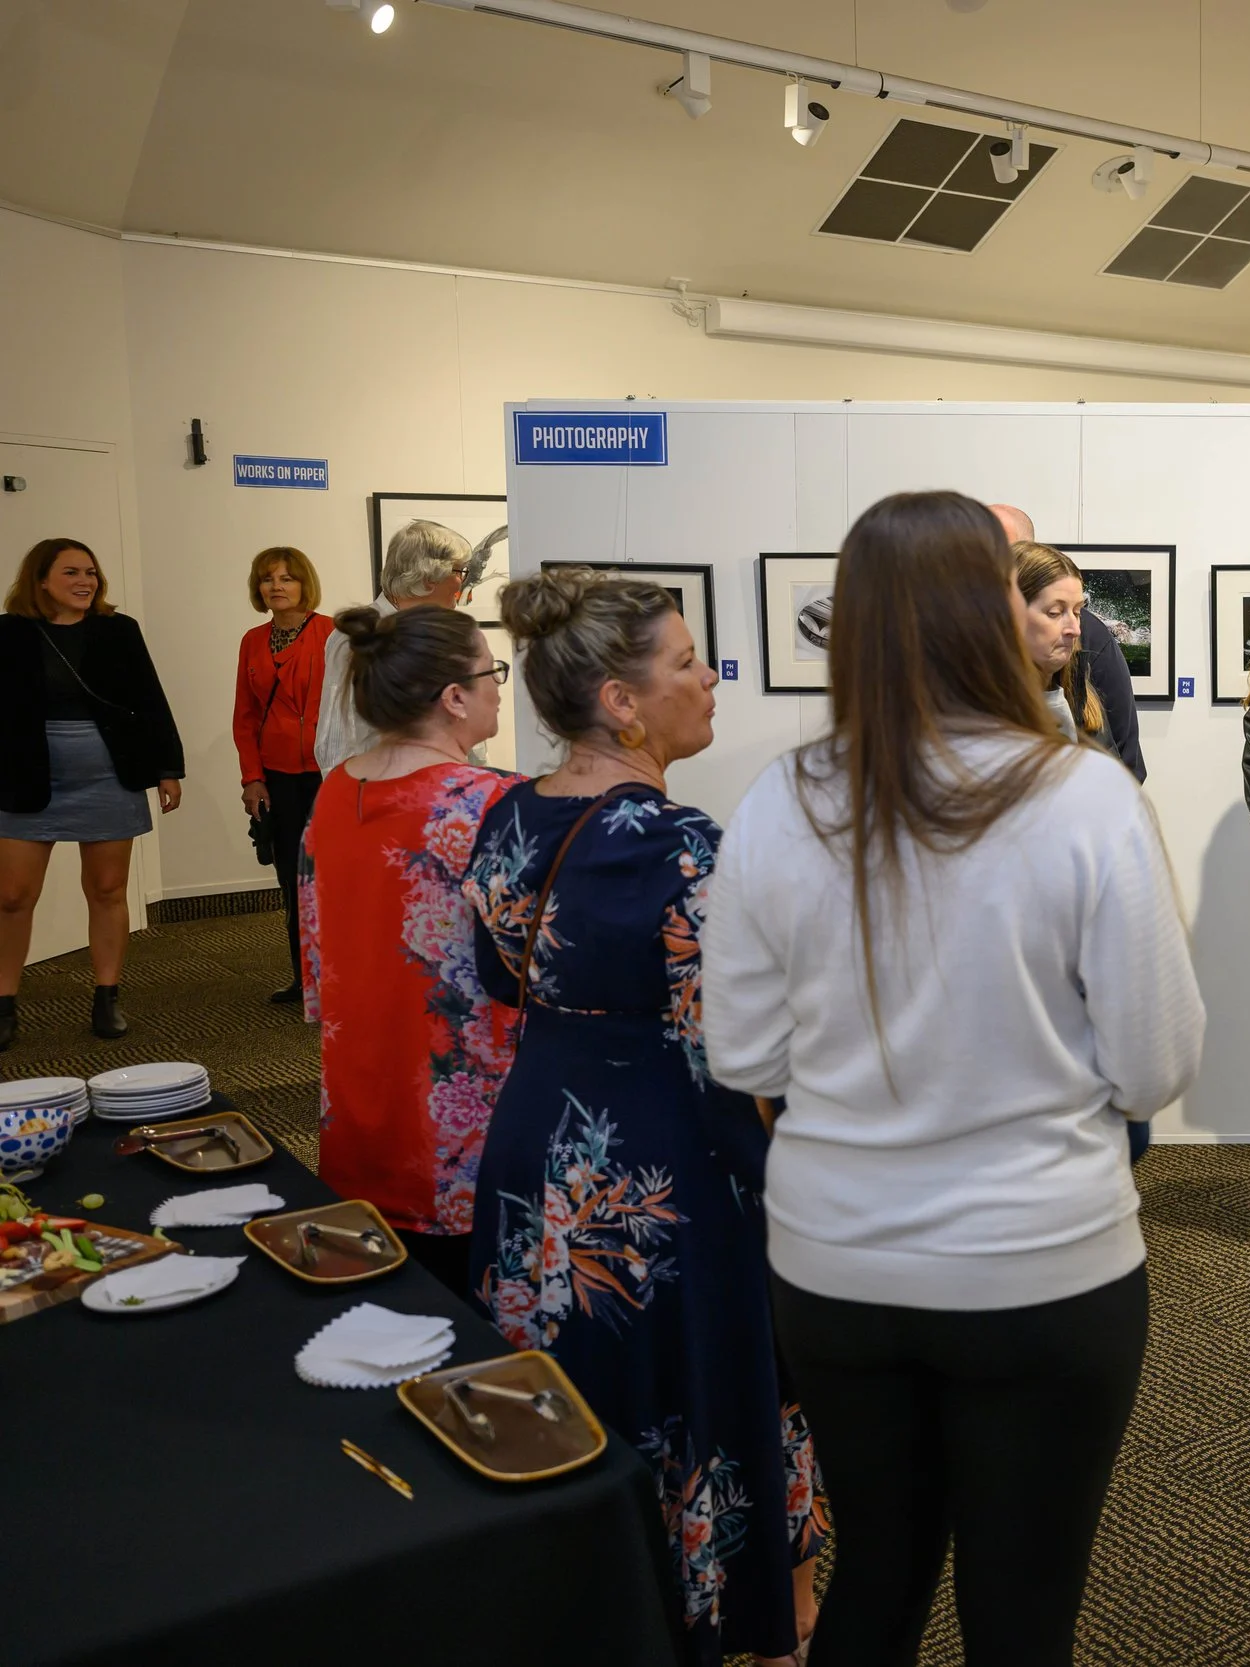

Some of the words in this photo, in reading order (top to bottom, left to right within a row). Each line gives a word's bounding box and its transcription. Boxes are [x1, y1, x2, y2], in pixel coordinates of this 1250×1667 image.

[532, 427, 649, 449] PHOTOGRAPHY
[237, 464, 275, 479] WORKS
[277, 466, 291, 480] ON
[293, 467, 325, 481] PAPER
